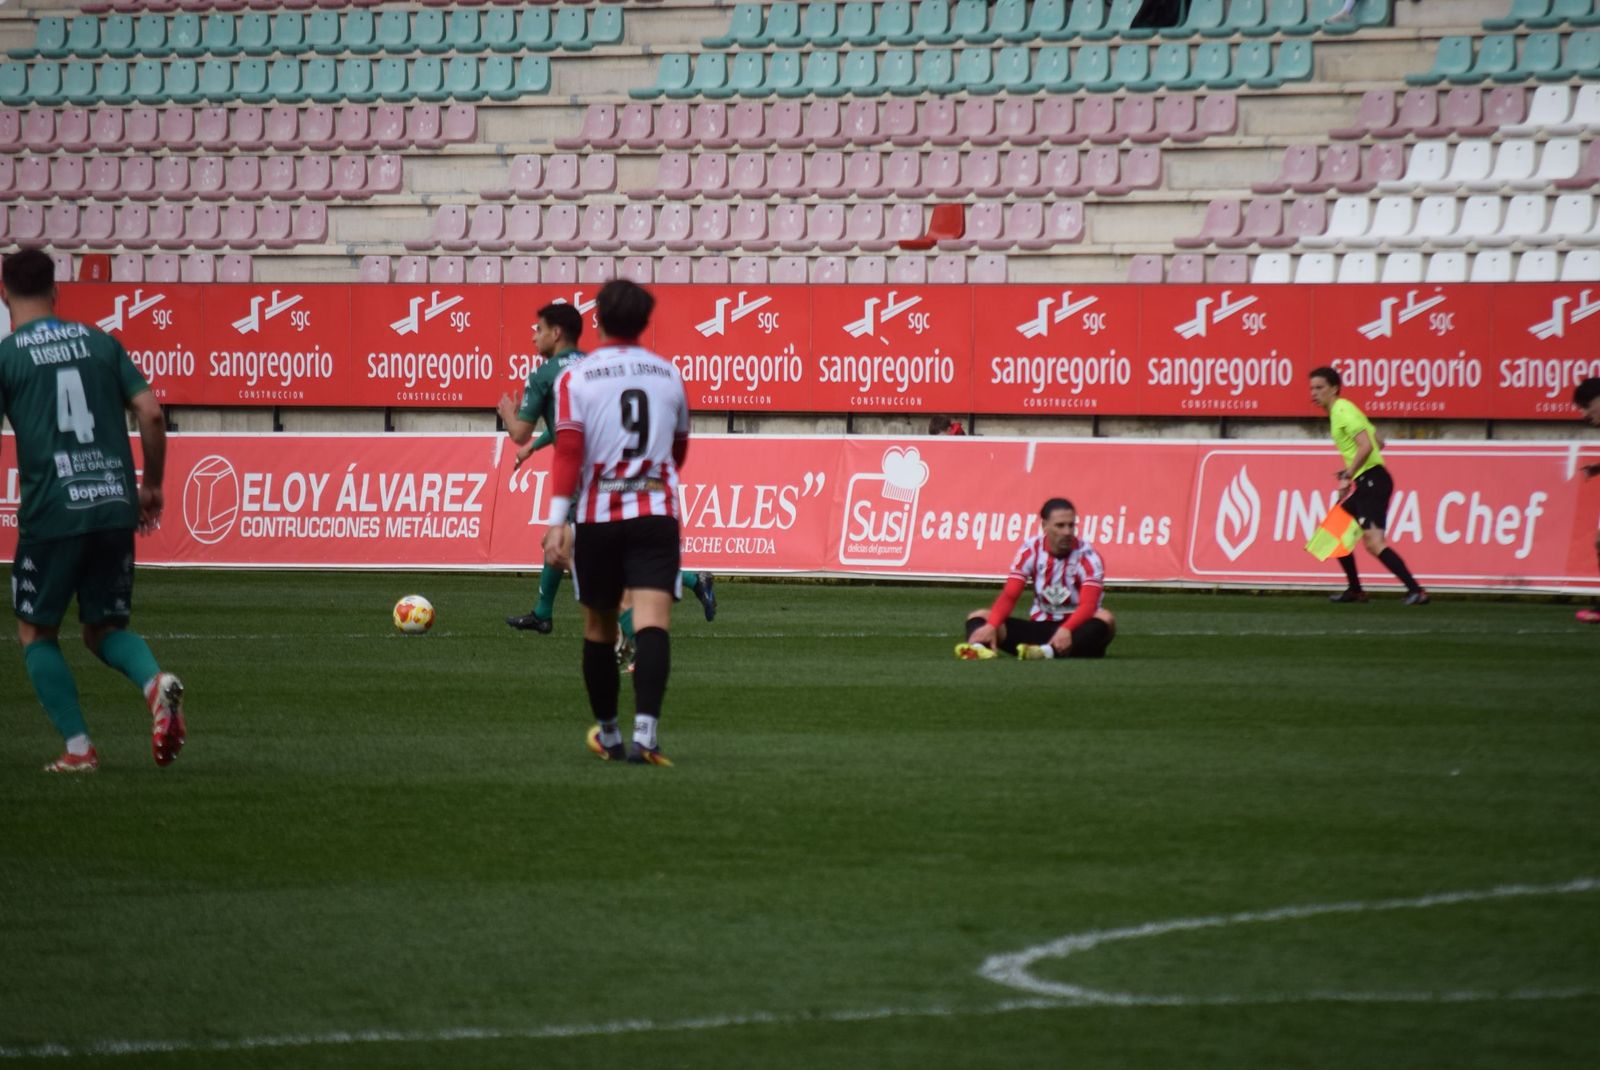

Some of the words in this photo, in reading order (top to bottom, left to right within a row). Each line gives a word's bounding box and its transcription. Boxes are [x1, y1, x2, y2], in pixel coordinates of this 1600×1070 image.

[152, 308, 173, 330] sgc
[290, 309, 311, 331] sgc
[450, 310, 471, 332] sgc
[757, 312, 779, 334] sgc
[908, 312, 930, 334] sgc
[1082, 313, 1106, 335] sgc
[1242, 313, 1267, 335] sgc
[1429, 313, 1455, 336] sgc
[127, 343, 195, 385] egorio
[209, 345, 333, 387] sangregorio
[368, 346, 493, 388] sangregorio
[671, 346, 803, 391] sangregorio
[819, 348, 954, 392] sangregorio
[991, 349, 1131, 394] sangregorio
[1148, 350, 1293, 395] sangregorio
[56, 367, 95, 444] 4
[239, 390, 304, 399] CONSTRUCCION
[397, 391, 463, 401] CONSTRUCCION
[702, 395, 771, 404] CONSTRUCCION
[851, 397, 922, 406] CONSTRUCCION
[1023, 398, 1097, 407] CONSTRUCCION
[619, 388, 649, 459] 9
[68, 484, 124, 502] Bopeixe
[242, 472, 330, 513] ELOY
[336, 463, 487, 513] ÁLVAREZ
[240, 516, 380, 539] CONTRUCCIONES
[385, 511, 480, 539] METÁLICAS
[849, 500, 910, 542] Susi
[1273, 489, 1423, 543] INNVA
[1435, 490, 1548, 559] Chef
[725, 537, 777, 554] CRUDA
